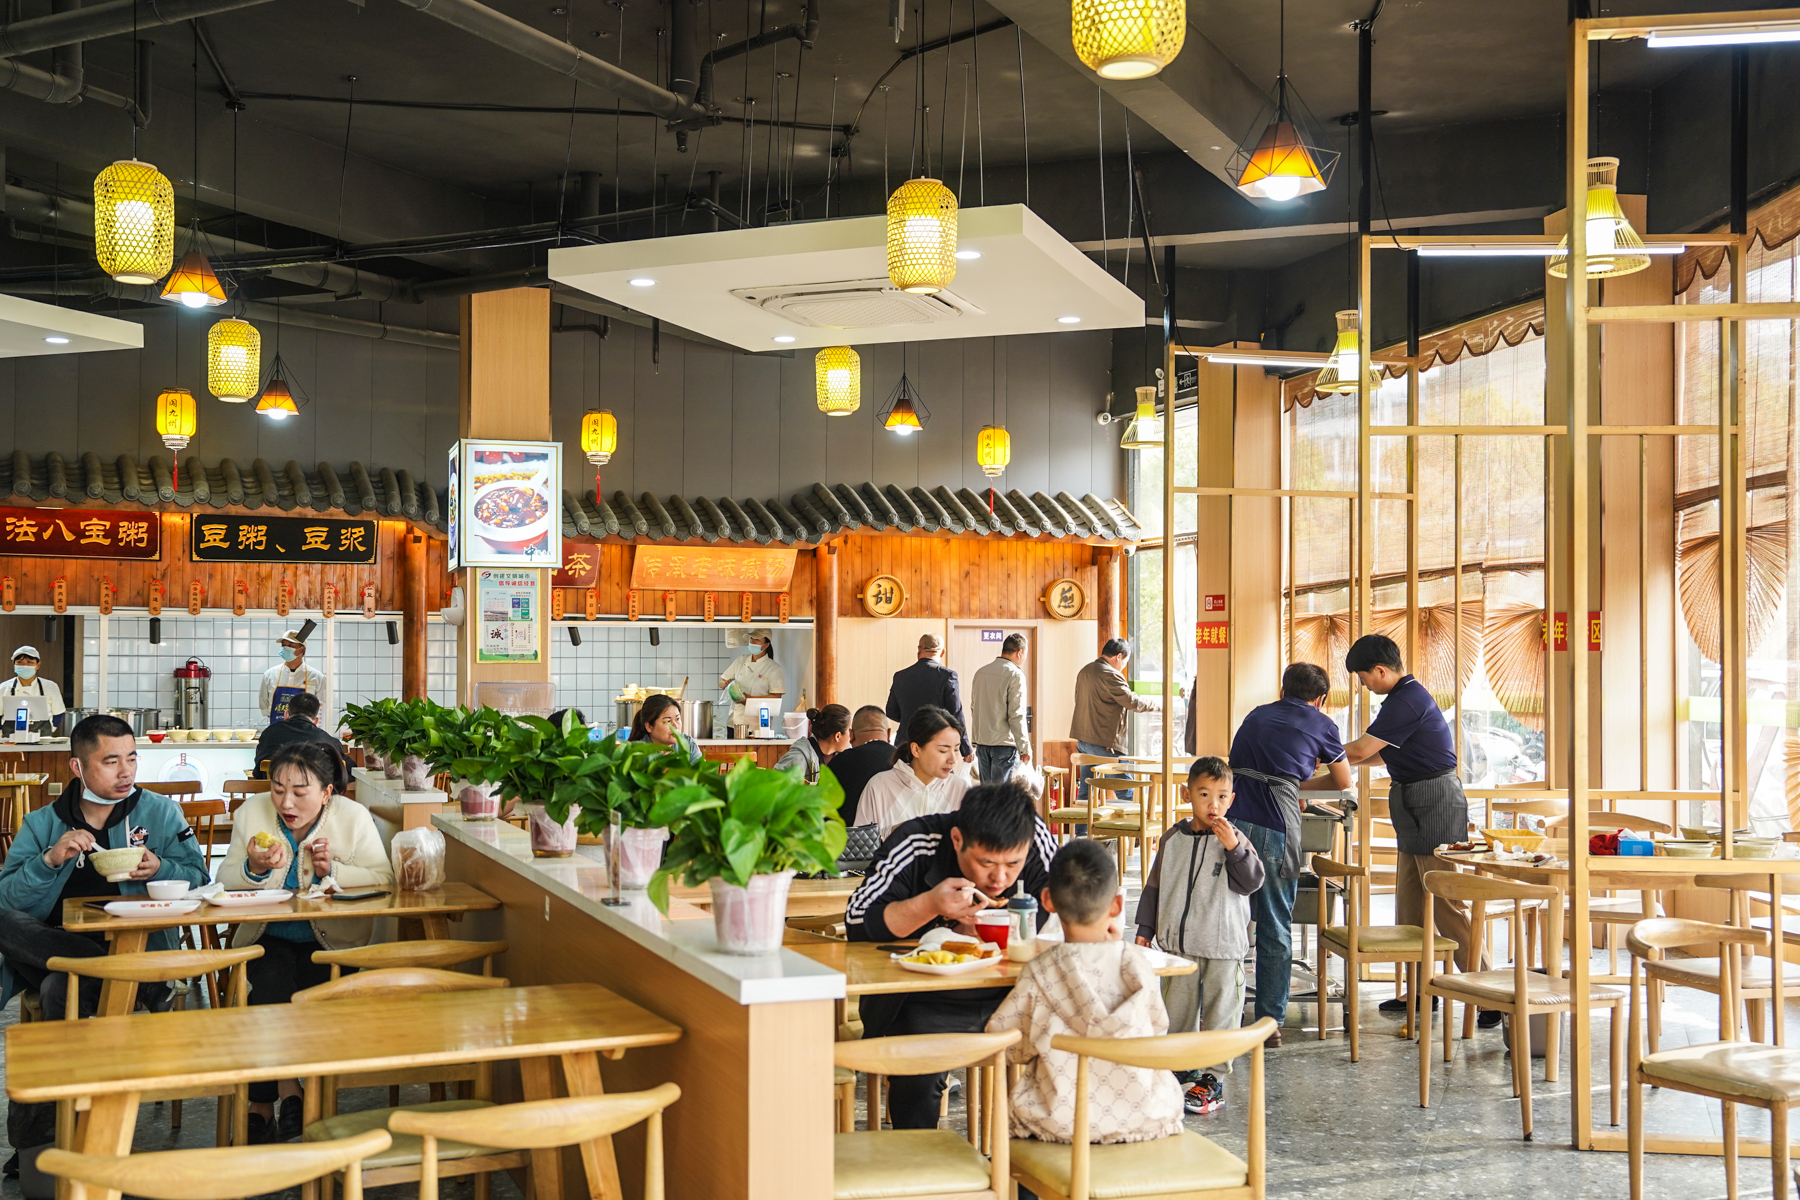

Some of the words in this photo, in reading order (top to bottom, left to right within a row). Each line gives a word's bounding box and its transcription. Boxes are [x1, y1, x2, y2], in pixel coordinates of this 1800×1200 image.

[6, 516, 150, 548] 法八宝粥
[199, 523, 368, 554] 豆粥、豆浆
[552, 552, 593, 579] 茶
[873, 583, 894, 606] 甜
[983, 631, 1002, 641] 更衣间
[1196, 626, 1229, 645] 老年就餐
